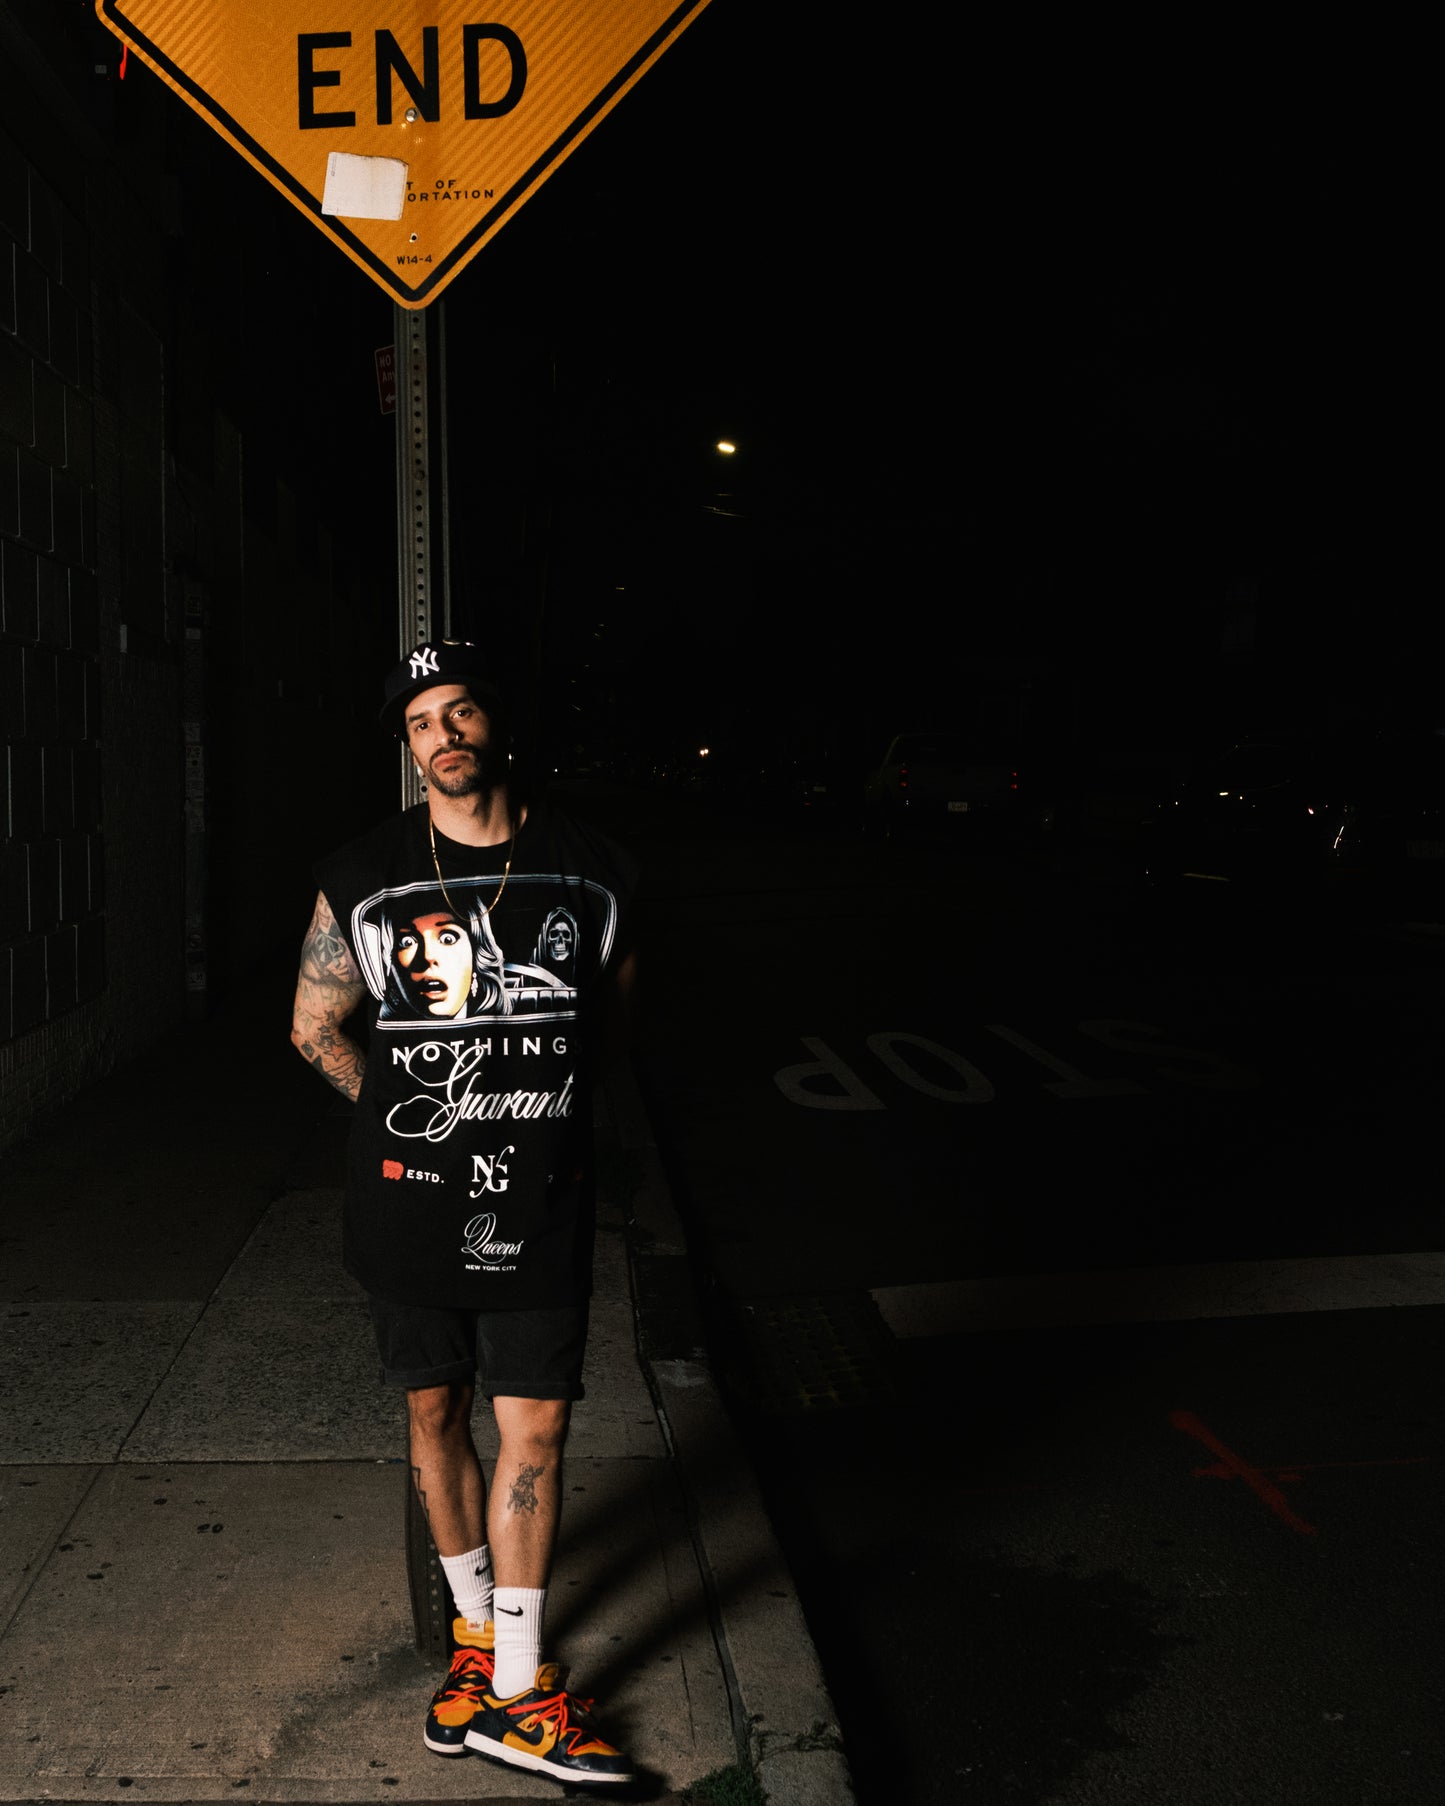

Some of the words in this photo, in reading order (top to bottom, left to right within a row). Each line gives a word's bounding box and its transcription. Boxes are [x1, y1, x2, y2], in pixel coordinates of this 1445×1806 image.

[298, 23, 527, 130] END
[435, 180, 456, 189] OF
[396, 254, 433, 265] W14-4
[408, 647, 440, 679] NY
[773, 1018, 1264, 1111] STOP
[406, 1169, 445, 1184] ESTD.
[461, 1212, 524, 1264] Queens
